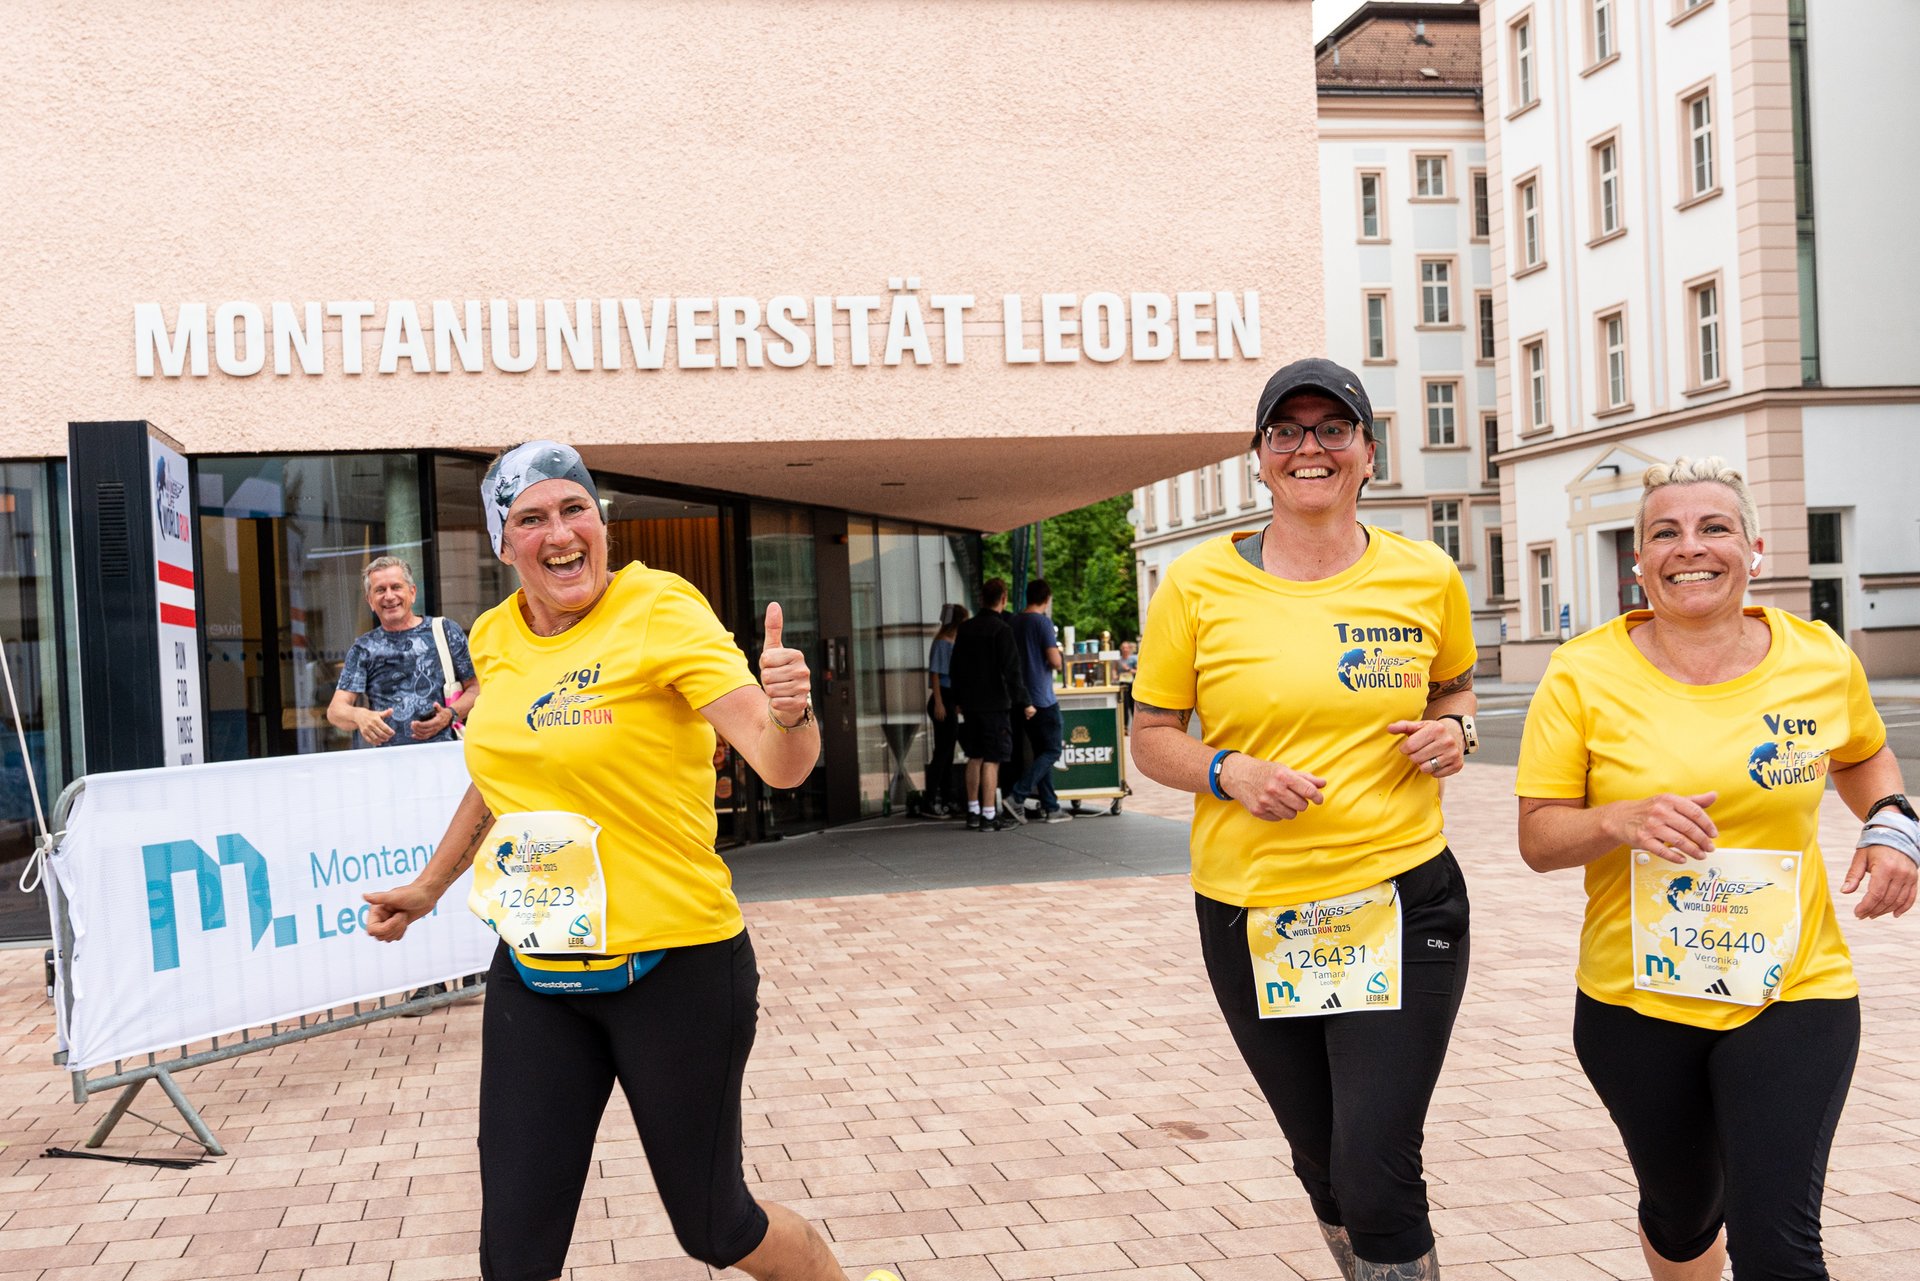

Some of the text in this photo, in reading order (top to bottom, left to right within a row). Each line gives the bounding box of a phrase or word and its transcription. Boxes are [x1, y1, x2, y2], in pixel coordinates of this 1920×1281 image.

[134, 277, 1262, 378] MONTANUNIVERSITÄT LEOBEN
[1333, 623, 1423, 643] Tamara
[175, 641, 186, 670] RUN
[1366, 655, 1400, 667] WINGS
[1355, 673, 1422, 688] WORLD RUN
[177, 679, 188, 707] FOR
[537, 709, 613, 728] WORLD RUN
[1763, 714, 1817, 736] Vero
[177, 716, 193, 745] THOSE
[1768, 764, 1816, 786] WORLD
[516, 841, 551, 854] WINGS
[543, 863, 558, 872] 2025
[1696, 879, 1746, 893] WINGS
[499, 886, 575, 908] 126423
[1702, 890, 1732, 903] LIFE
[1300, 906, 1344, 920] WINGS
[1683, 902, 1749, 915] WORLD RUN 2025
[1308, 916, 1332, 927] LIFE
[1292, 924, 1351, 937] WORLD RUN 2025
[1669, 926, 1765, 953] 126440
[1284, 944, 1367, 969] 126431
[1694, 953, 1739, 966] Veronika
[1704, 963, 1729, 972] Leoben
[1312, 970, 1346, 980] Tamara
[1366, 994, 1389, 1002] LEOBEN
